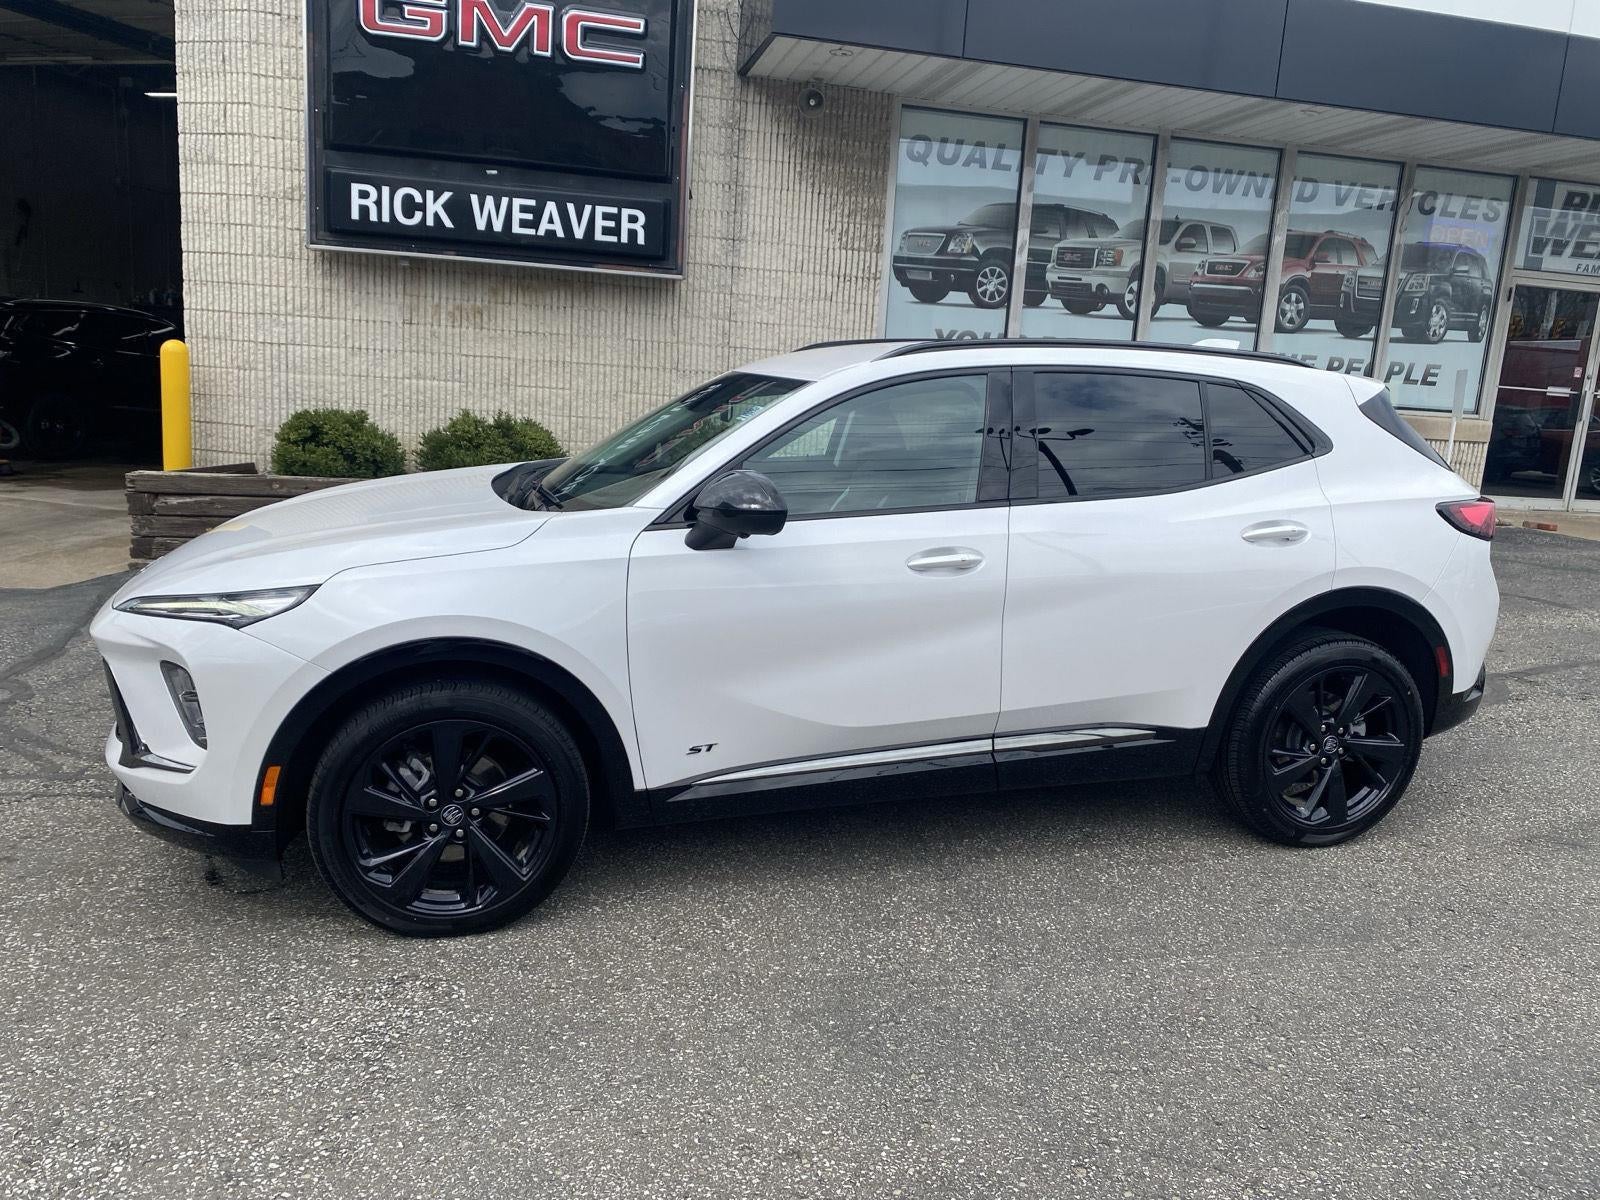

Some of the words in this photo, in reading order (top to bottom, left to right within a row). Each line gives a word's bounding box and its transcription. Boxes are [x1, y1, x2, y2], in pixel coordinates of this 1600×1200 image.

[358, 0, 646, 69] GMC
[905, 133, 1086, 179] QUALTY
[1093, 154, 1320, 204] PR-OWND
[1334, 180, 1505, 223] VEHCLES
[350, 182, 455, 229] RICK
[470, 193, 646, 246] WEAVER
[1575, 263, 1600, 274] FAM
[686, 742, 718, 755] ST
